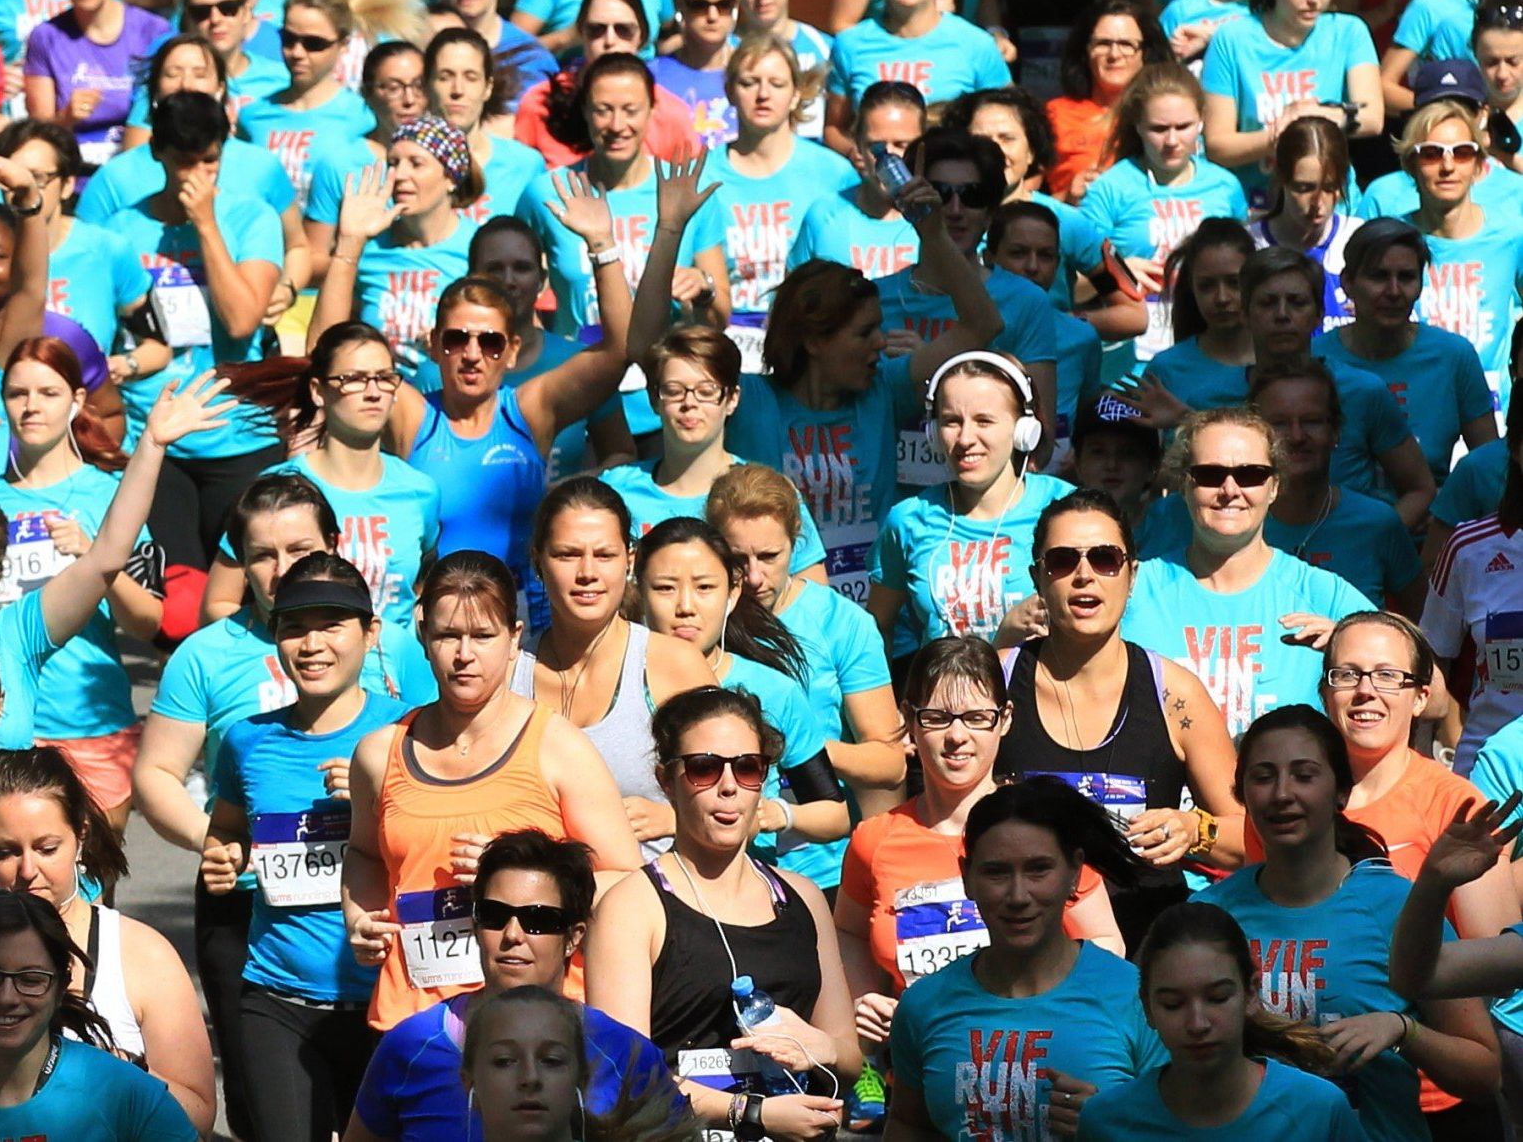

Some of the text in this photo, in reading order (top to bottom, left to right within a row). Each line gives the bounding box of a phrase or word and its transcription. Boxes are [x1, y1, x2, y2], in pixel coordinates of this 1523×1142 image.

[876, 61, 936, 96] VIE
[1260, 71, 1318, 100] VIE
[732, 202, 792, 242] VIE
[1428, 262, 1484, 298] VIE
[786, 425, 858, 467] VIE
[781, 452, 856, 493] RUN
[950, 536, 1014, 577] VIE
[935, 564, 1005, 606] RUN
[1183, 624, 1265, 673] VIE
[257, 850, 337, 880] 13769
[1257, 970, 1318, 1021] UN
[971, 1029, 1054, 1080] VIE
[953, 1060, 1038, 1109] RUN
